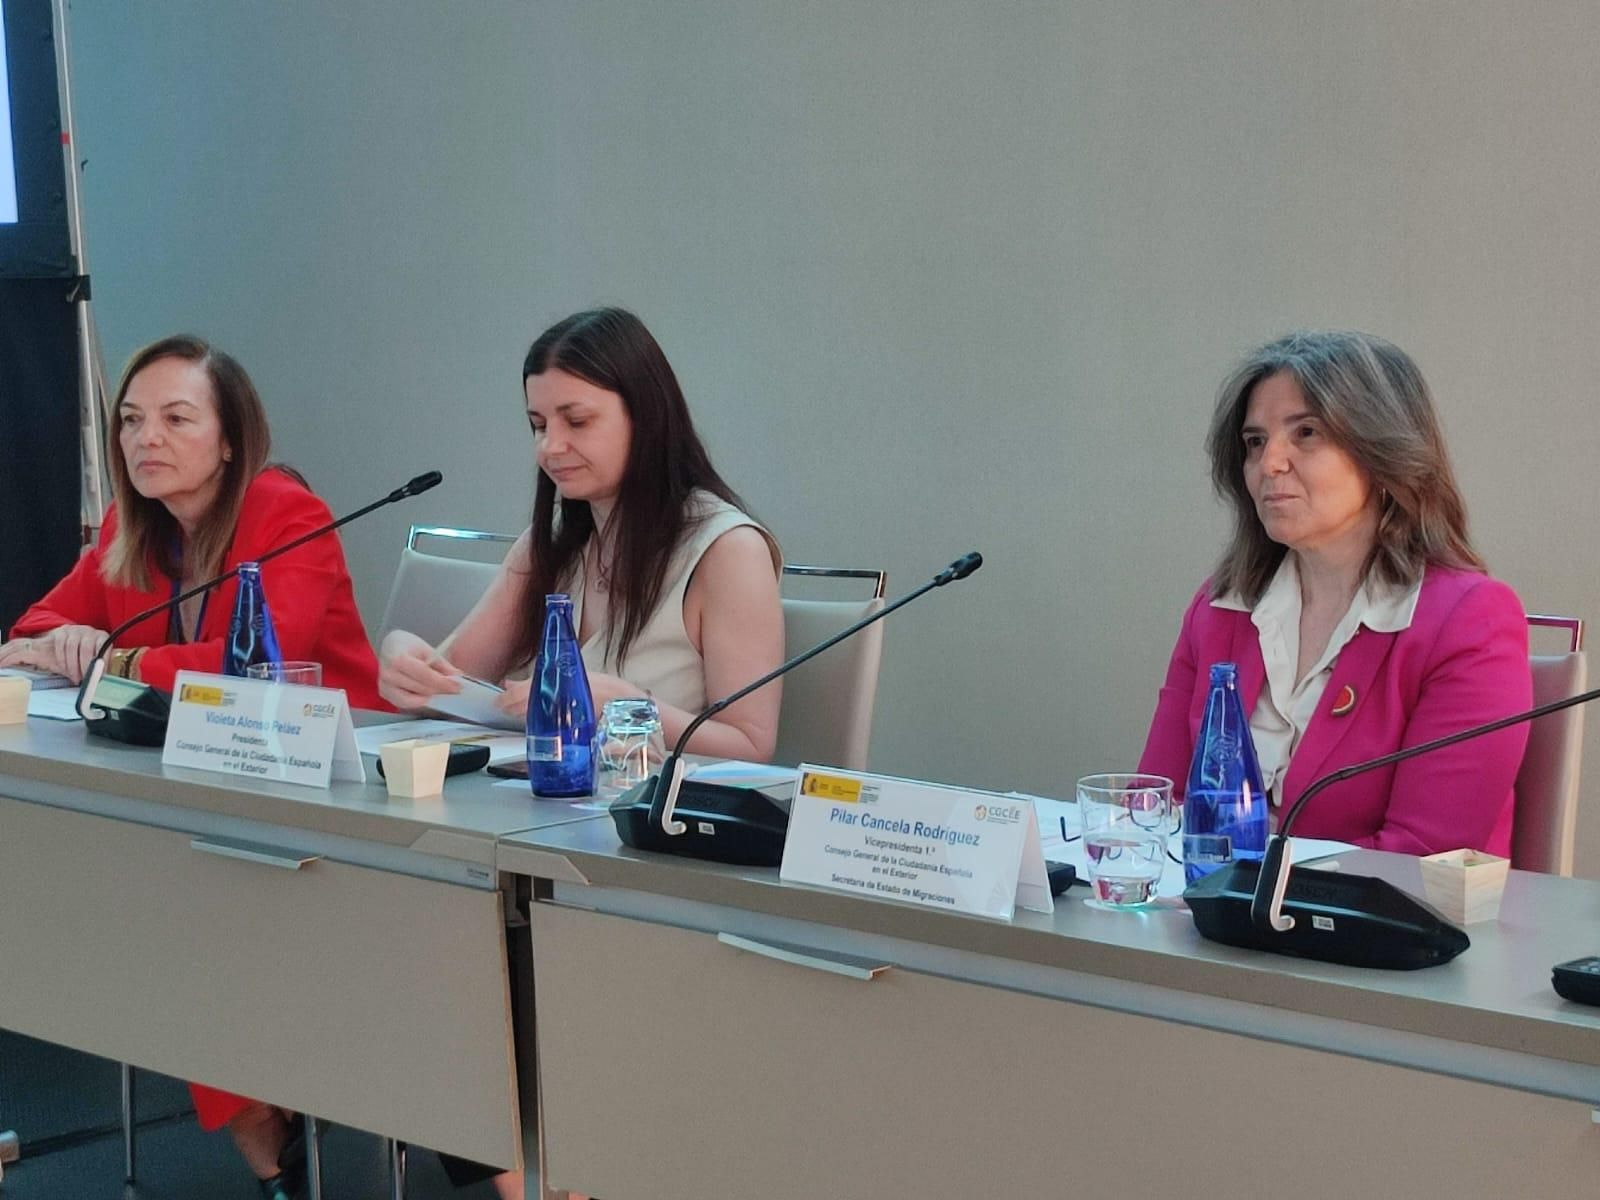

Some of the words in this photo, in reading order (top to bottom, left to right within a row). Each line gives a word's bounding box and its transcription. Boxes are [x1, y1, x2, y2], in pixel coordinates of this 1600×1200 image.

[206, 710, 236, 727] Violeta
[237, 715, 269, 731] Alonso
[205, 743, 230, 756] General
[231, 748, 240, 758] de
[240, 762, 268, 775] Exterior
[830, 807, 858, 825] Pilar
[861, 812, 910, 834] Cancela
[913, 820, 980, 848] Rodríguez
[825, 844, 851, 859] Consejo
[853, 849, 879, 862] General
[881, 855, 890, 864] de
[891, 855, 897, 865] la
[865, 835, 922, 855] Vicepresidenta
[882, 866, 889, 875] el
[890, 866, 918, 880] Exterior
[866, 879, 875, 889] de
[877, 881, 901, 893] Estado
[902, 887, 911, 896] de
[912, 888, 955, 905] Migraciones
